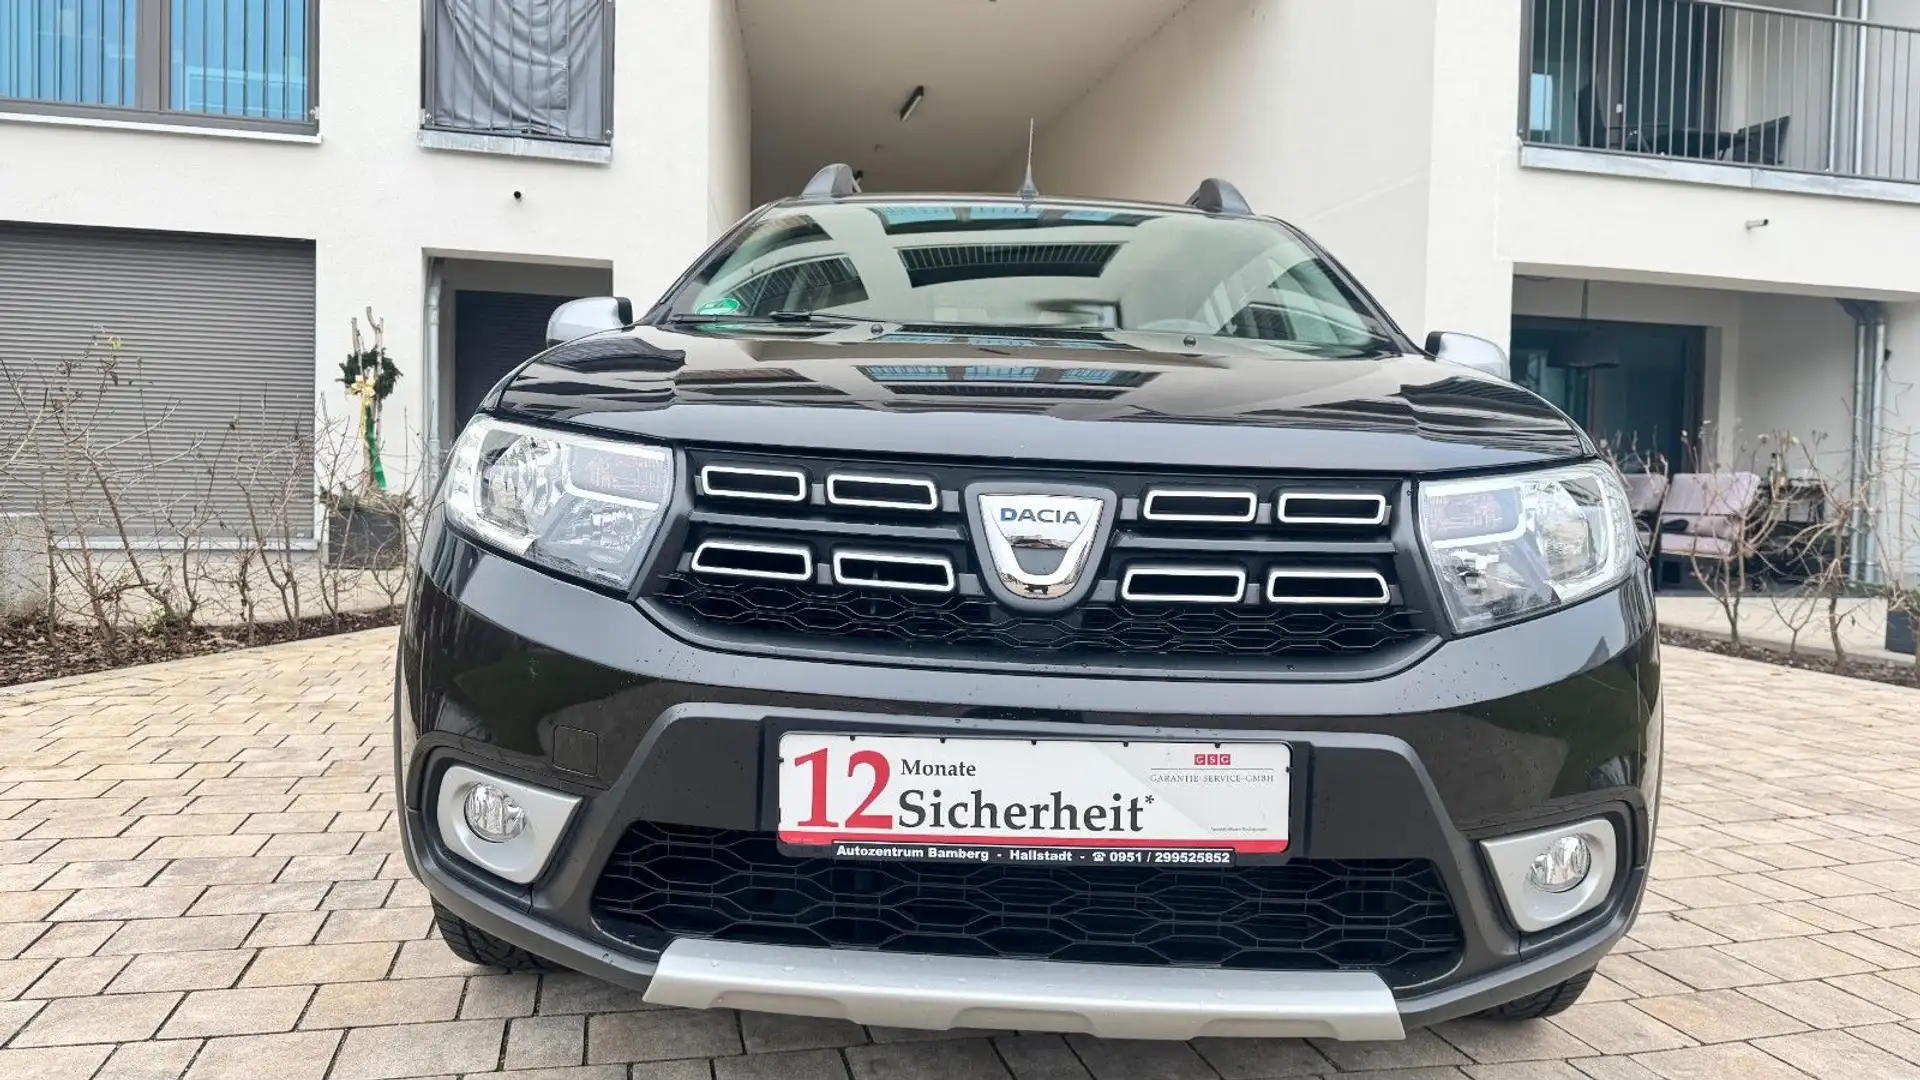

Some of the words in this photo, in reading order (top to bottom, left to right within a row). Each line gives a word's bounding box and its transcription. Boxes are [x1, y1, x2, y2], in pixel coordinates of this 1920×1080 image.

[1000, 507, 1081, 525] DACIA
[900, 758, 977, 778] Monate
[1194, 753, 1231, 766] GSG
[794, 747, 893, 830] 12
[836, 844, 924, 858] Autozentrum
[927, 847, 989, 862] Bamberg
[1009, 849, 1073, 862] Hallstadt
[1109, 851, 1142, 863] 0951
[1154, 852, 1230, 864] 299525852
